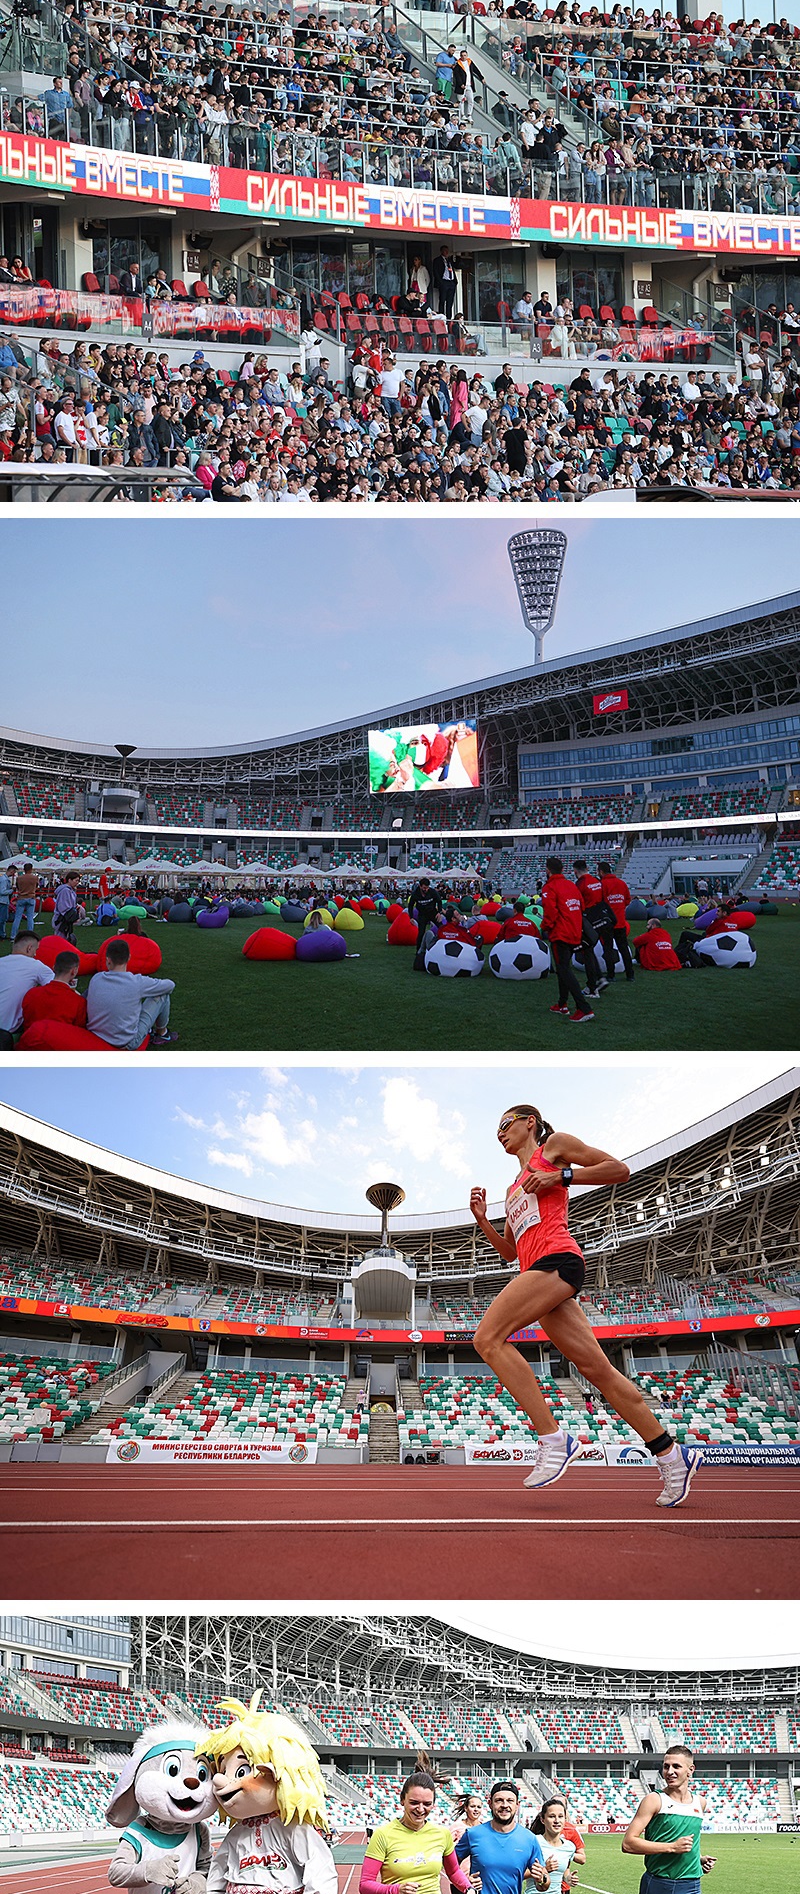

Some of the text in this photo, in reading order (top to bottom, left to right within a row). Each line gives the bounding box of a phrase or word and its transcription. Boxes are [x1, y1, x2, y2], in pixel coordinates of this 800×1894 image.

[86, 151, 185, 203] ВМЕСТЕ
[247, 174, 372, 224] СИЛЬНЫЕ
[380, 189, 486, 234] ВМЕСТЕ
[549, 205, 683, 246] СИЛЬНЫЕ
[692, 215, 800, 252] ВМЕСТЕ
[532, 343, 541, 353] A3
[0, 1298, 19, 1310] a
[58, 1304, 68, 1314] 5
[152, 1443, 282, 1452] МИНИСТЕРСТВО СПОРТА И ТУРИЗМА
[173, 1452, 261, 1461] РЕСПУБЛИКИ БЕЛАРУСЬ
[472, 1450, 501, 1459] БФЛА
[702, 1456, 751, 1465] РАХОВОЧНАЯ
